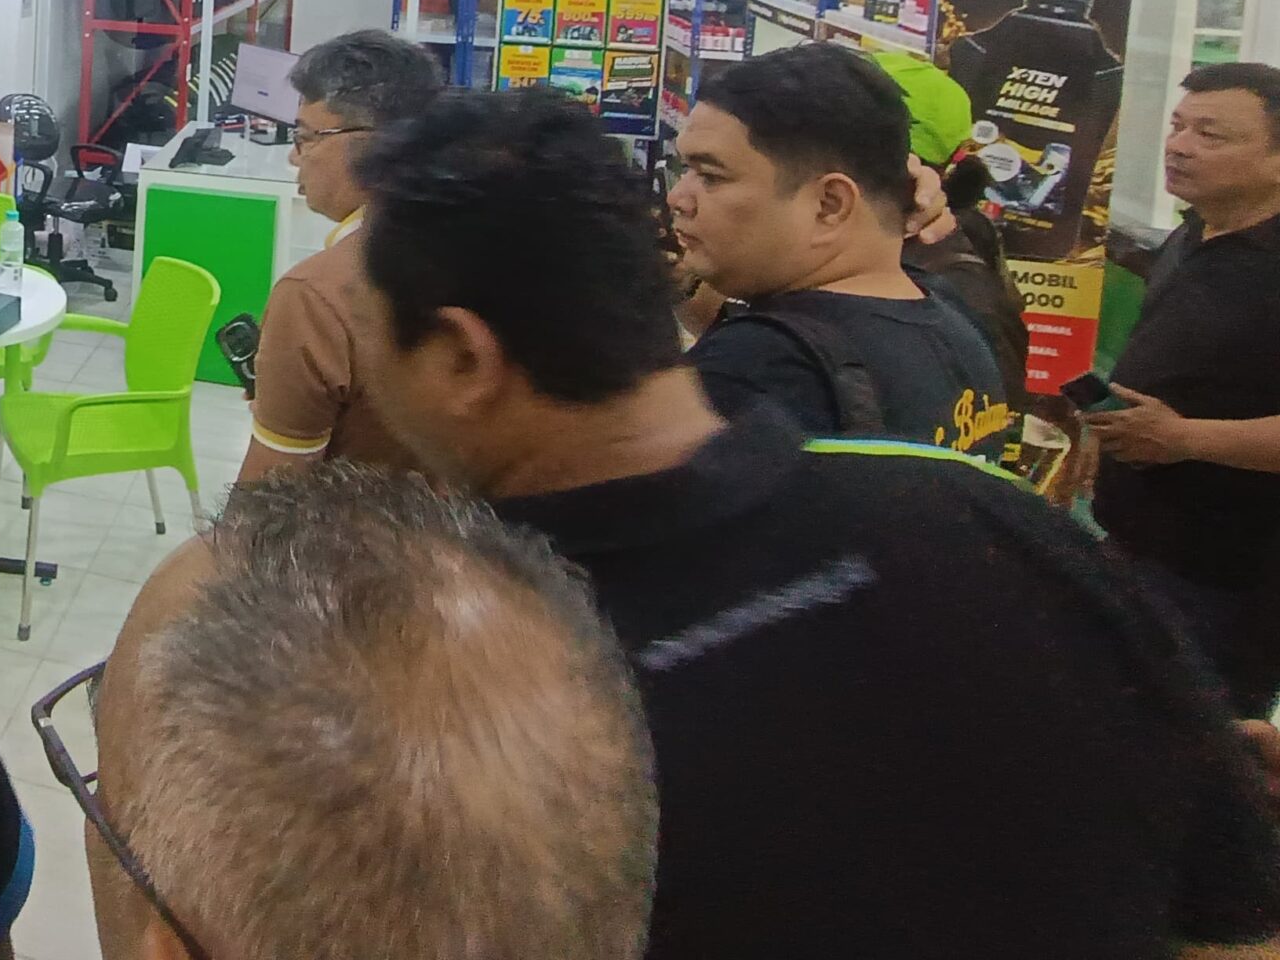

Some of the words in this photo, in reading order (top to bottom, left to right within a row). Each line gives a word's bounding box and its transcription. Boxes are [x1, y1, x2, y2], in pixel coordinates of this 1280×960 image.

[1006, 66, 1069, 89] X-TEN
[1000, 80, 1059, 103] HIGH
[996, 96, 1061, 118] MILEAGE
[1011, 270, 1078, 290] MOBIL
